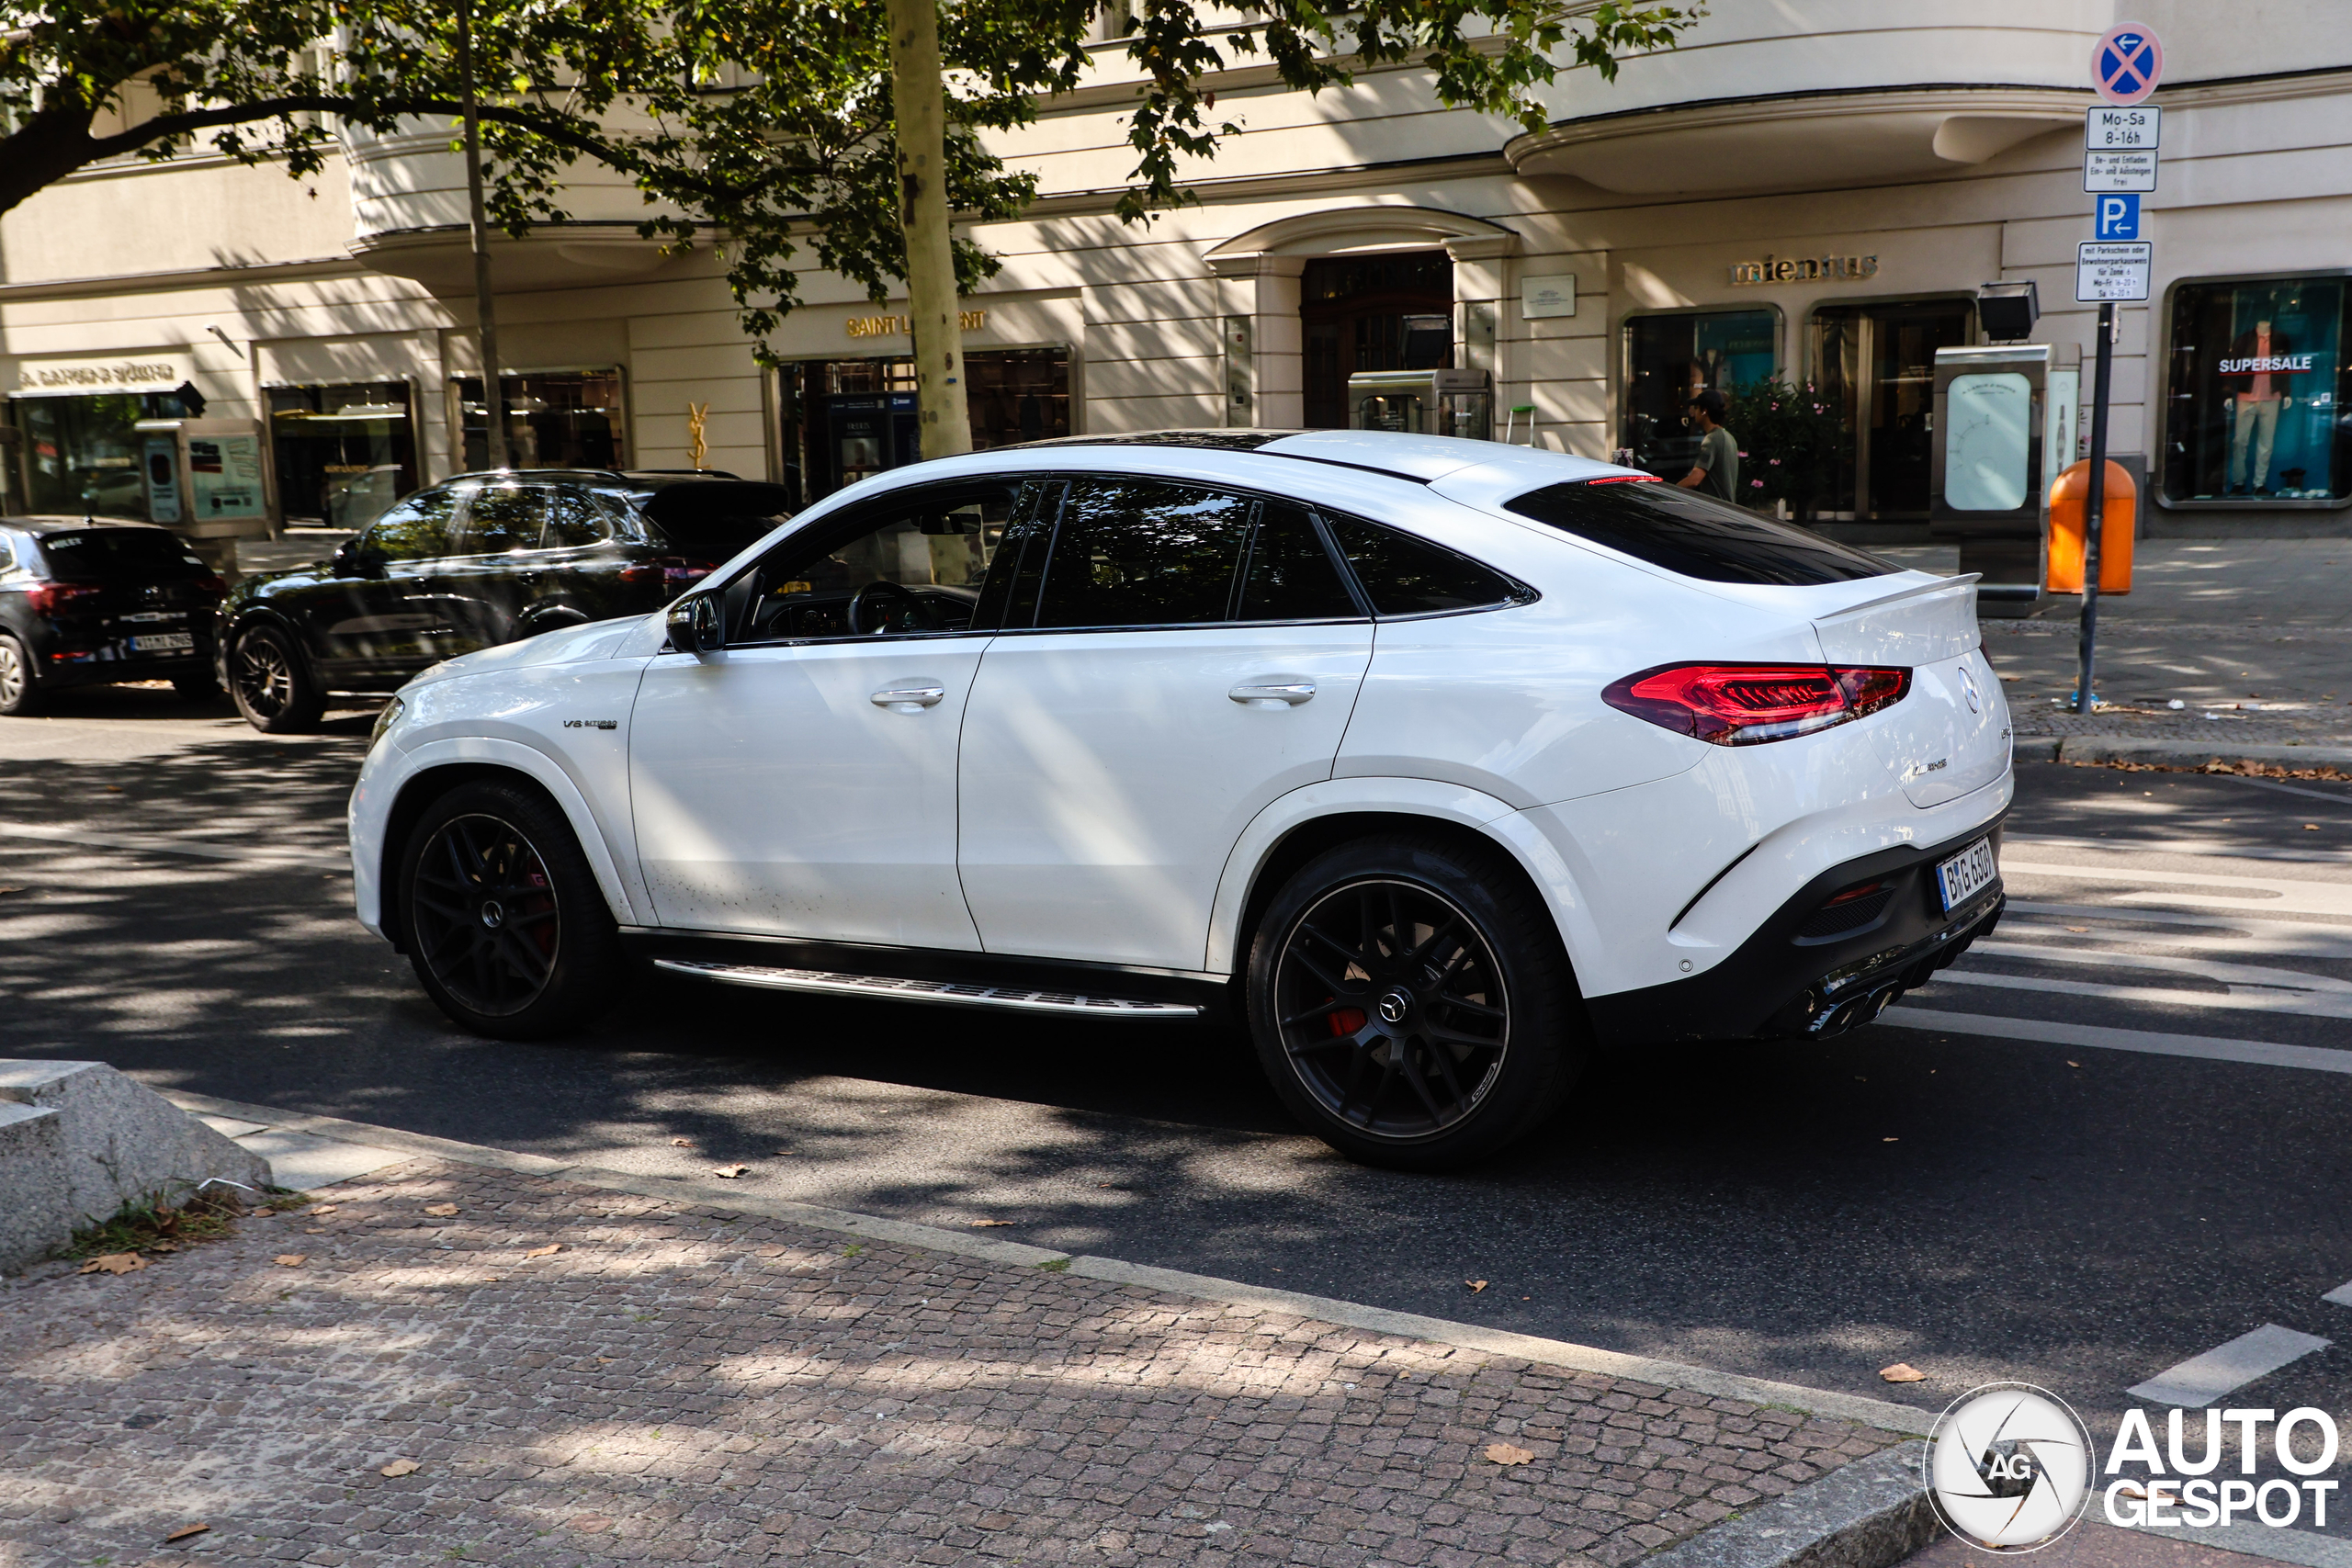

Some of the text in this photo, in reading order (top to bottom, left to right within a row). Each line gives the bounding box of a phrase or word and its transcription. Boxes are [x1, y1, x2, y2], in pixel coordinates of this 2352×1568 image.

[2102, 112, 2145, 126] Mo-Sa
[2106, 131, 2141, 144] 8-16h
[2121, 155, 2147, 164] Entladen
[2090, 166, 2151, 176] Ein- und Aussteigen
[2102, 197, 2127, 234] P
[2097, 246, 2130, 254] Parkschein
[2081, 257, 2147, 265] Bewohnerparkausweis
[1729, 254, 1879, 284] mientus
[2098, 267, 2107, 276] für
[2109, 267, 2123, 276] Zone
[846, 315, 899, 338] SAINT
[2219, 355, 2312, 373] SUPERSALE
[1947, 867, 1958, 901] B
[1961, 858, 1972, 892] G
